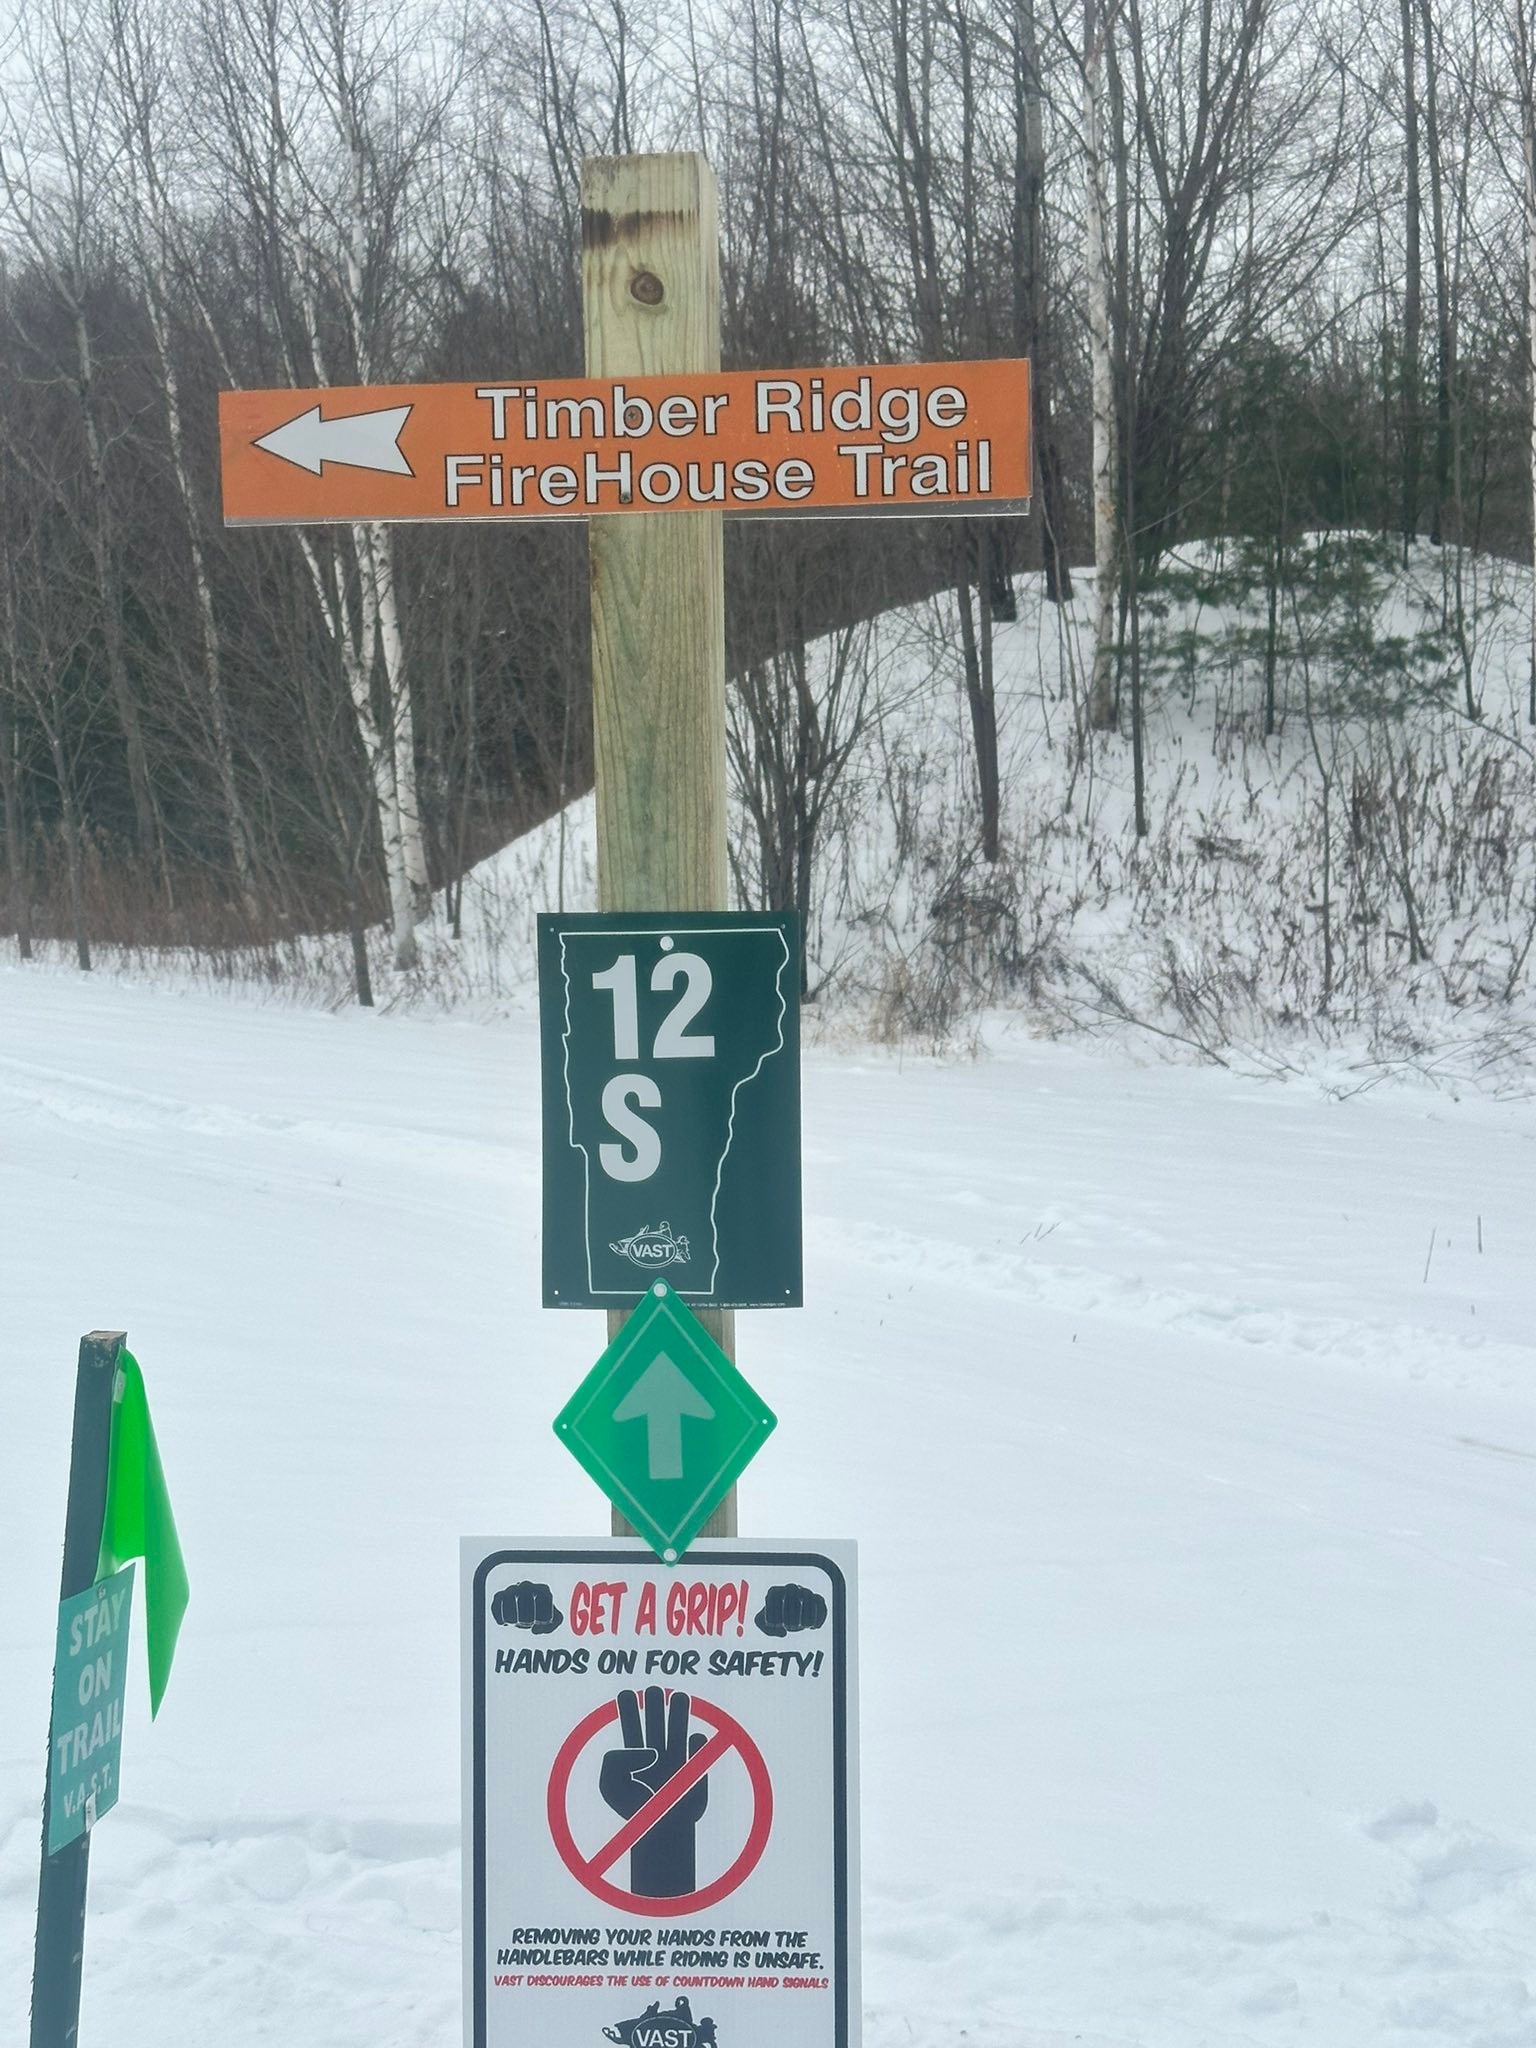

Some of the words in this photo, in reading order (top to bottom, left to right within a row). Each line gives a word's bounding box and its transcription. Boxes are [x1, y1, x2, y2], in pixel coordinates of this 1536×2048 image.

[476, 385, 728, 439] Timber
[756, 377, 967, 442] Ridge
[444, 451, 816, 508] FireHouse
[836, 439, 993, 499] Trail
[592, 952, 716, 1060] 12
[599, 1073, 662, 1183] S
[632, 1243, 672, 1259] VAST
[69, 1589, 125, 1657] STAY
[569, 1579, 628, 1637] GET
[634, 1581, 657, 1636] A
[666, 1579, 750, 1638] GRIP!
[78, 1651, 112, 1706] ON
[495, 1648, 590, 1674] HANDS
[599, 1649, 638, 1675] ON
[645, 1649, 698, 1675] FOR
[708, 1649, 824, 1678] SAFETY!
[57, 1697, 122, 1776] TRAIL
[497, 1949, 609, 1967] HANDLEBARS
[613, 1949, 665, 1968] WHILE
[670, 1950, 729, 1969] RIDING
[733, 1951, 751, 1969] IS
[755, 1951, 825, 1970] UNSAFE.
[512, 1928, 600, 1946] REMOVING
[606, 1928, 651, 1946] YOUR
[657, 1929, 716, 1947] HANDS
[720, 1930, 769, 1948] FROM
[774, 1931, 808, 1949] THE
[494, 1975, 523, 1987] VAST
[526, 1975, 604, 1987] DISCOURAGES
[607, 1975, 629, 1987] THE
[631, 1975, 652, 1987] USE
[655, 1975, 669, 1988] OF
[672, 1975, 745, 1988] COUNTDOWN
[748, 1976, 780, 1988] HAND
[782, 1976, 830, 1989] SIGNALS
[635, 2029, 692, 2047] VAST
